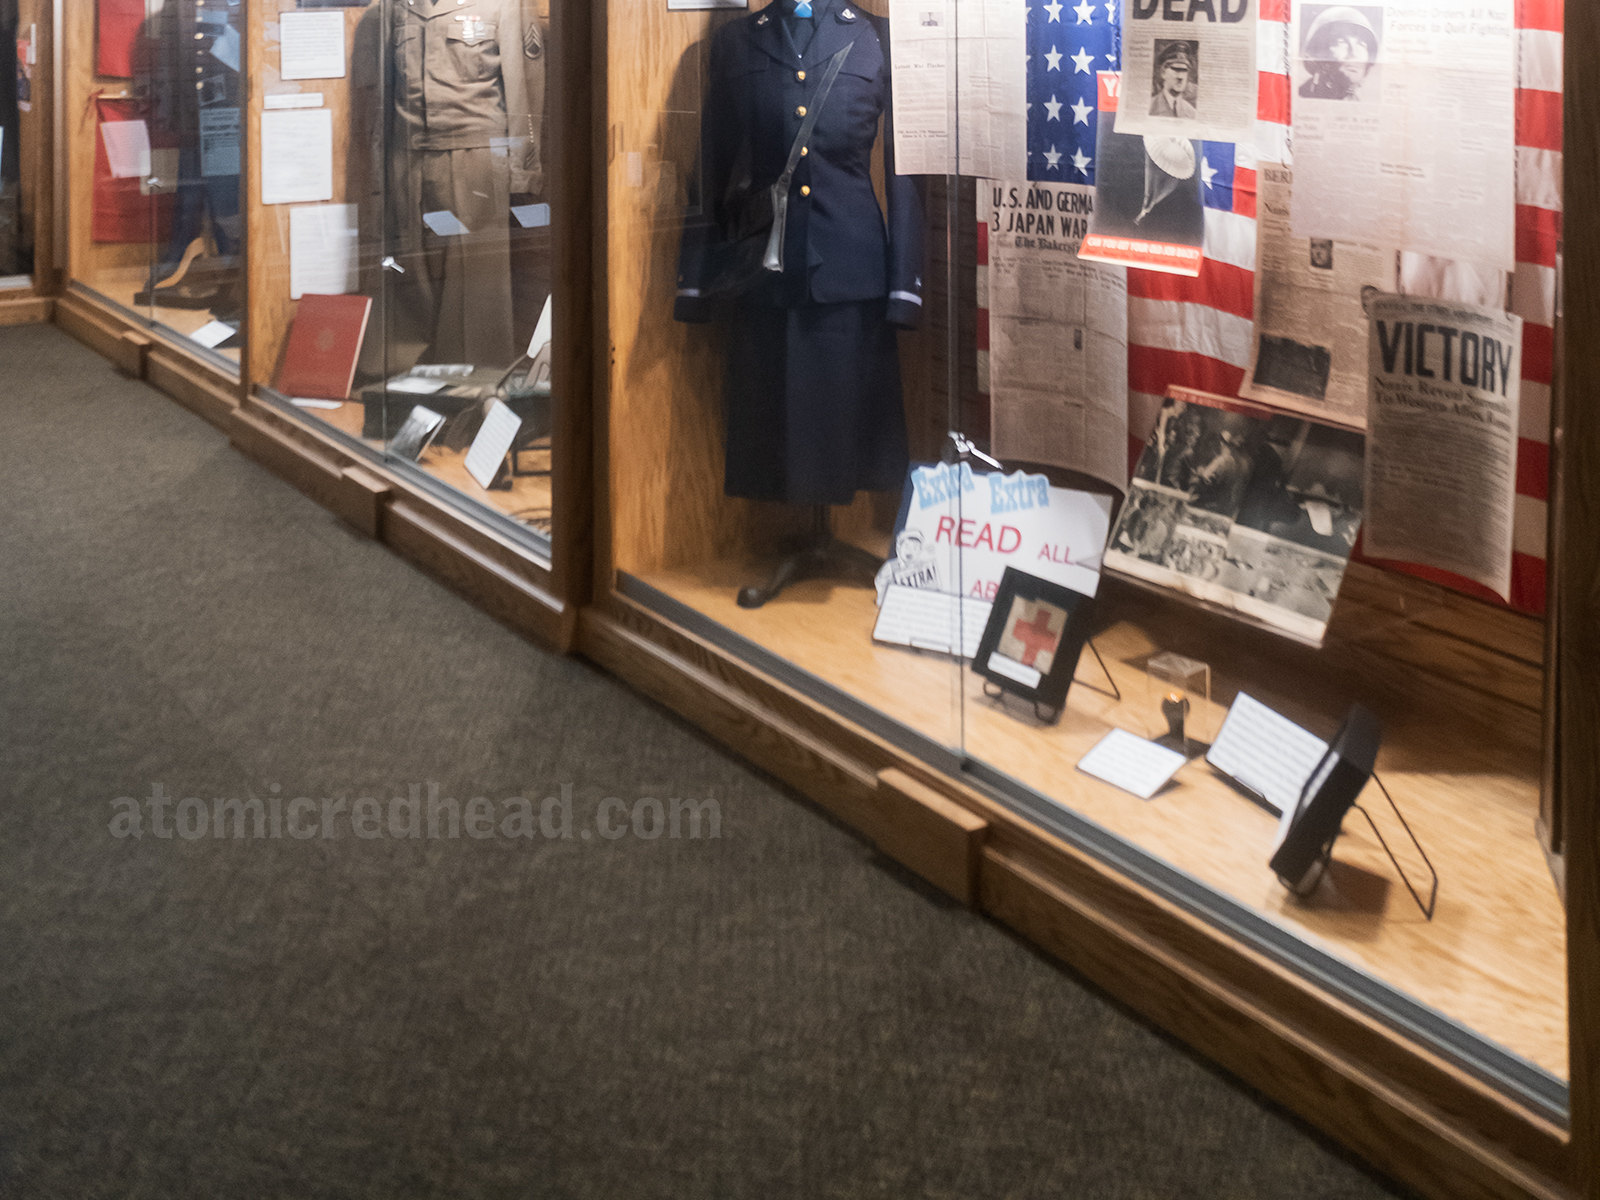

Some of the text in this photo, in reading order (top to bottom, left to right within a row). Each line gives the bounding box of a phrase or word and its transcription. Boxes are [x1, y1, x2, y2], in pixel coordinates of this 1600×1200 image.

[1430, 8, 1466, 19] Orders
[1390, 21, 1426, 32] Forces
[1444, 22, 1466, 34] Quit
[1026, 189, 1053, 210] AND
[992, 212, 1000, 232] 3
[1007, 213, 1054, 235] JAPAN
[1015, 236, 1035, 248] The
[1377, 320, 1513, 397] VICTORY
[911, 464, 1050, 514] Extra Extra
[935, 516, 1022, 554] READ
[1037, 543, 1076, 566] ALL
